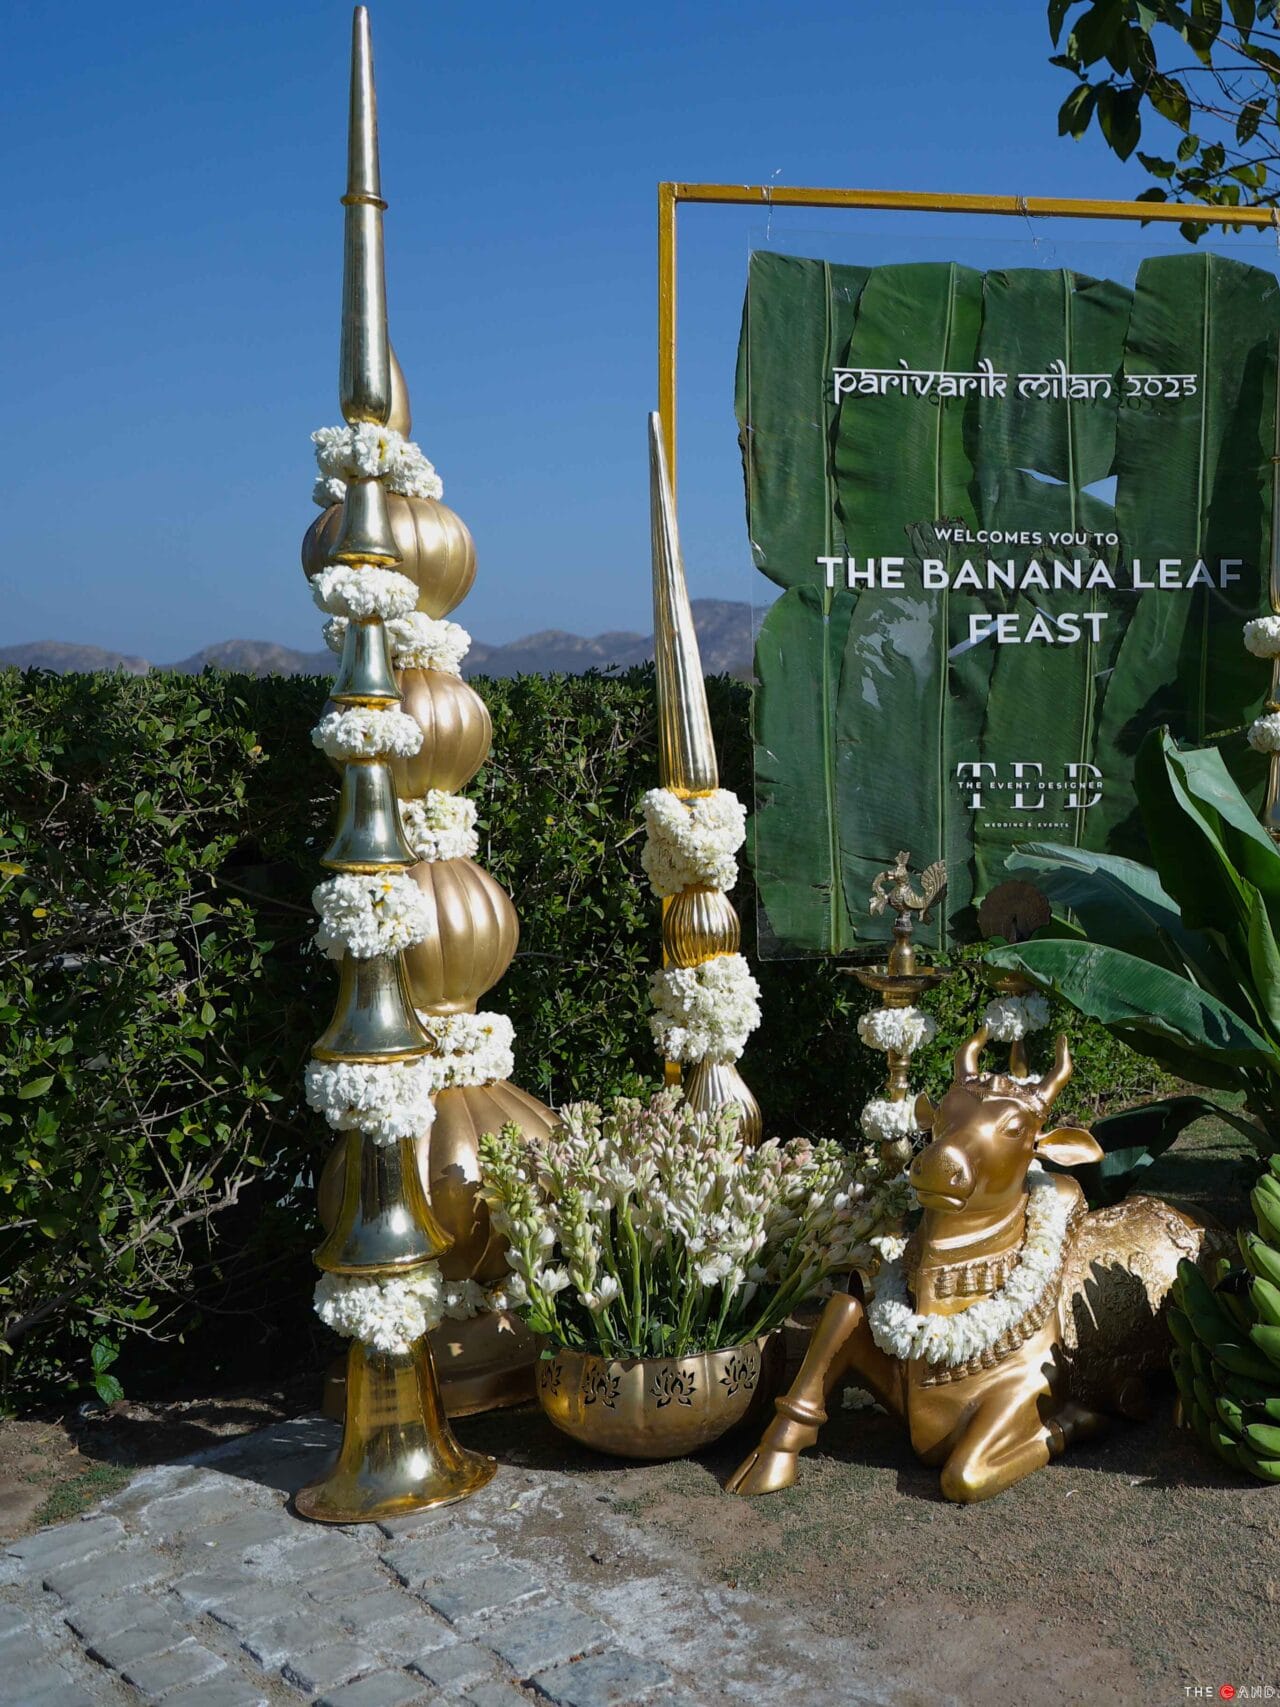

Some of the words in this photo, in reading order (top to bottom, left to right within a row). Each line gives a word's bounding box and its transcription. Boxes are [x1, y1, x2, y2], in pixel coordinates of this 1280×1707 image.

[834, 360, 1007, 404] parivarik
[1019, 360, 1112, 399] milan
[1125, 375, 1197, 398] 2025
[934, 527, 1042, 545] WELCOMES
[1049, 531, 1087, 546] YOU
[1094, 533, 1118, 545] TO
[817, 557, 905, 589] THE
[923, 559, 1116, 589] BANANA
[1133, 559, 1242, 589] LEAF
[969, 613, 1107, 643] FEAST
[957, 763, 1102, 808] TED
